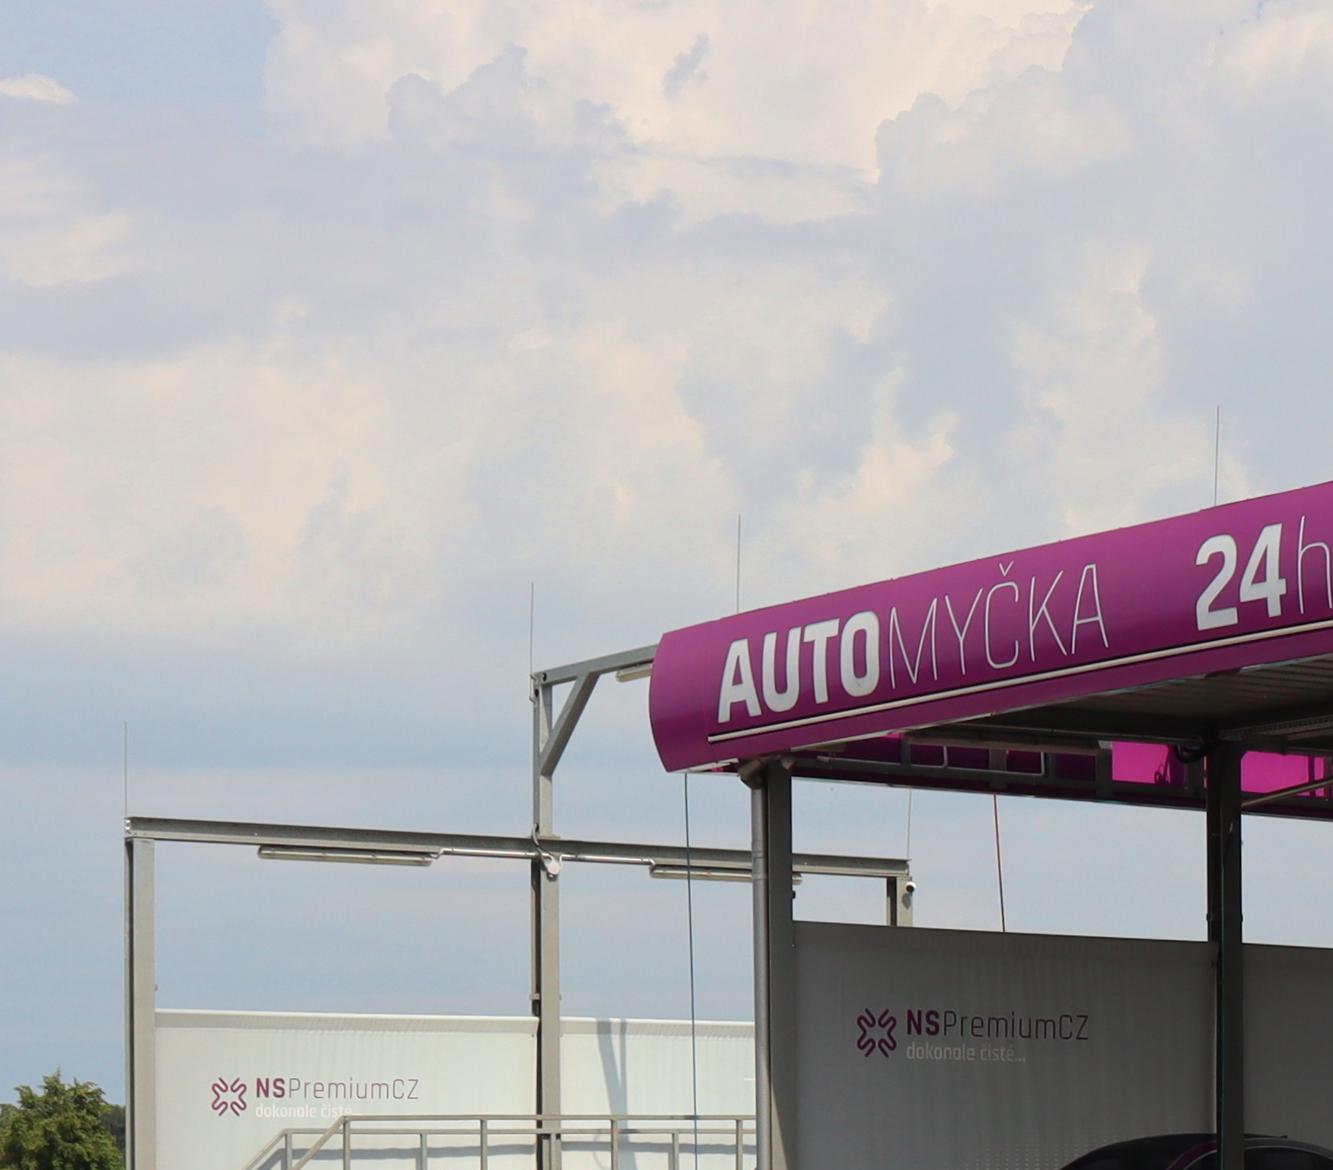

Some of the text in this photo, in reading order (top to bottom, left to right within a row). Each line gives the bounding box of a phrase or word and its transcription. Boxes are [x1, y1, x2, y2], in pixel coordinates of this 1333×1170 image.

[717, 561, 1110, 724] AUTOMYČKA
[906, 1009, 1090, 1041] NSPremiumCZ
[906, 1041, 976, 1061] dokonale
[255, 1077, 420, 1100] NSPremiumCZ
[255, 1103, 317, 1119] dokonale
